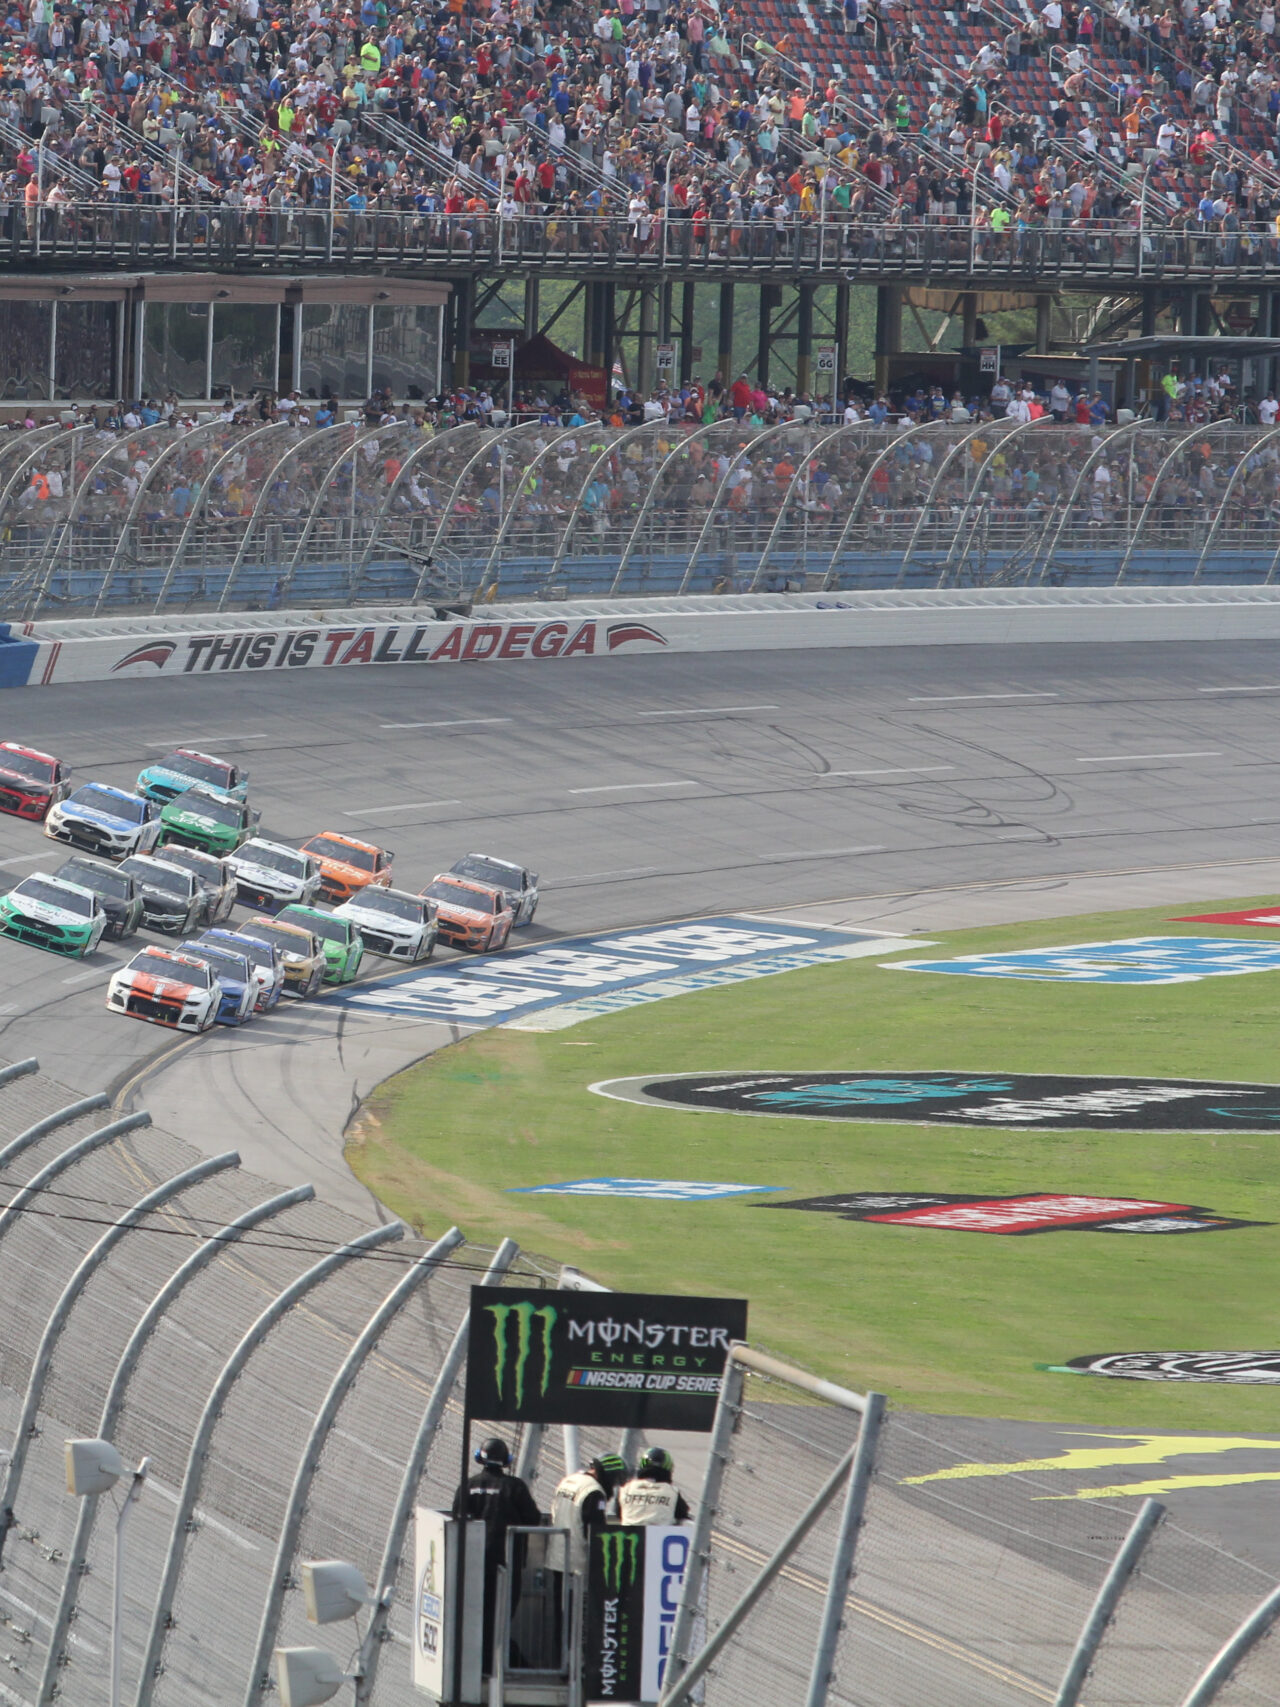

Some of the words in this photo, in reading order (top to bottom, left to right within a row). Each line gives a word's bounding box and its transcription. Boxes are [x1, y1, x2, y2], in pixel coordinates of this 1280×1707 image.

[493, 355, 508, 367] EE
[658, 357, 672, 367] FF
[818, 358, 834, 369] GG
[981, 360, 996, 371] HH
[183, 634, 271, 673] THIS
[275, 630, 320, 667] IS
[320, 618, 598, 667] TALLADEGA
[590, 925, 819, 961] GEICO
[458, 949, 680, 987] GEICO
[346, 976, 563, 1017] GEICO
[568, 1317, 731, 1350] MONSTER
[591, 1352, 707, 1368] ENERGY
[585, 1371, 644, 1390] NASCAR
[645, 1374, 676, 1390] CUP
[676, 1376, 724, 1393] SERIES
[599, 1597, 620, 1696] MONSTER
[620, 1612, 629, 1682] ENERGY
